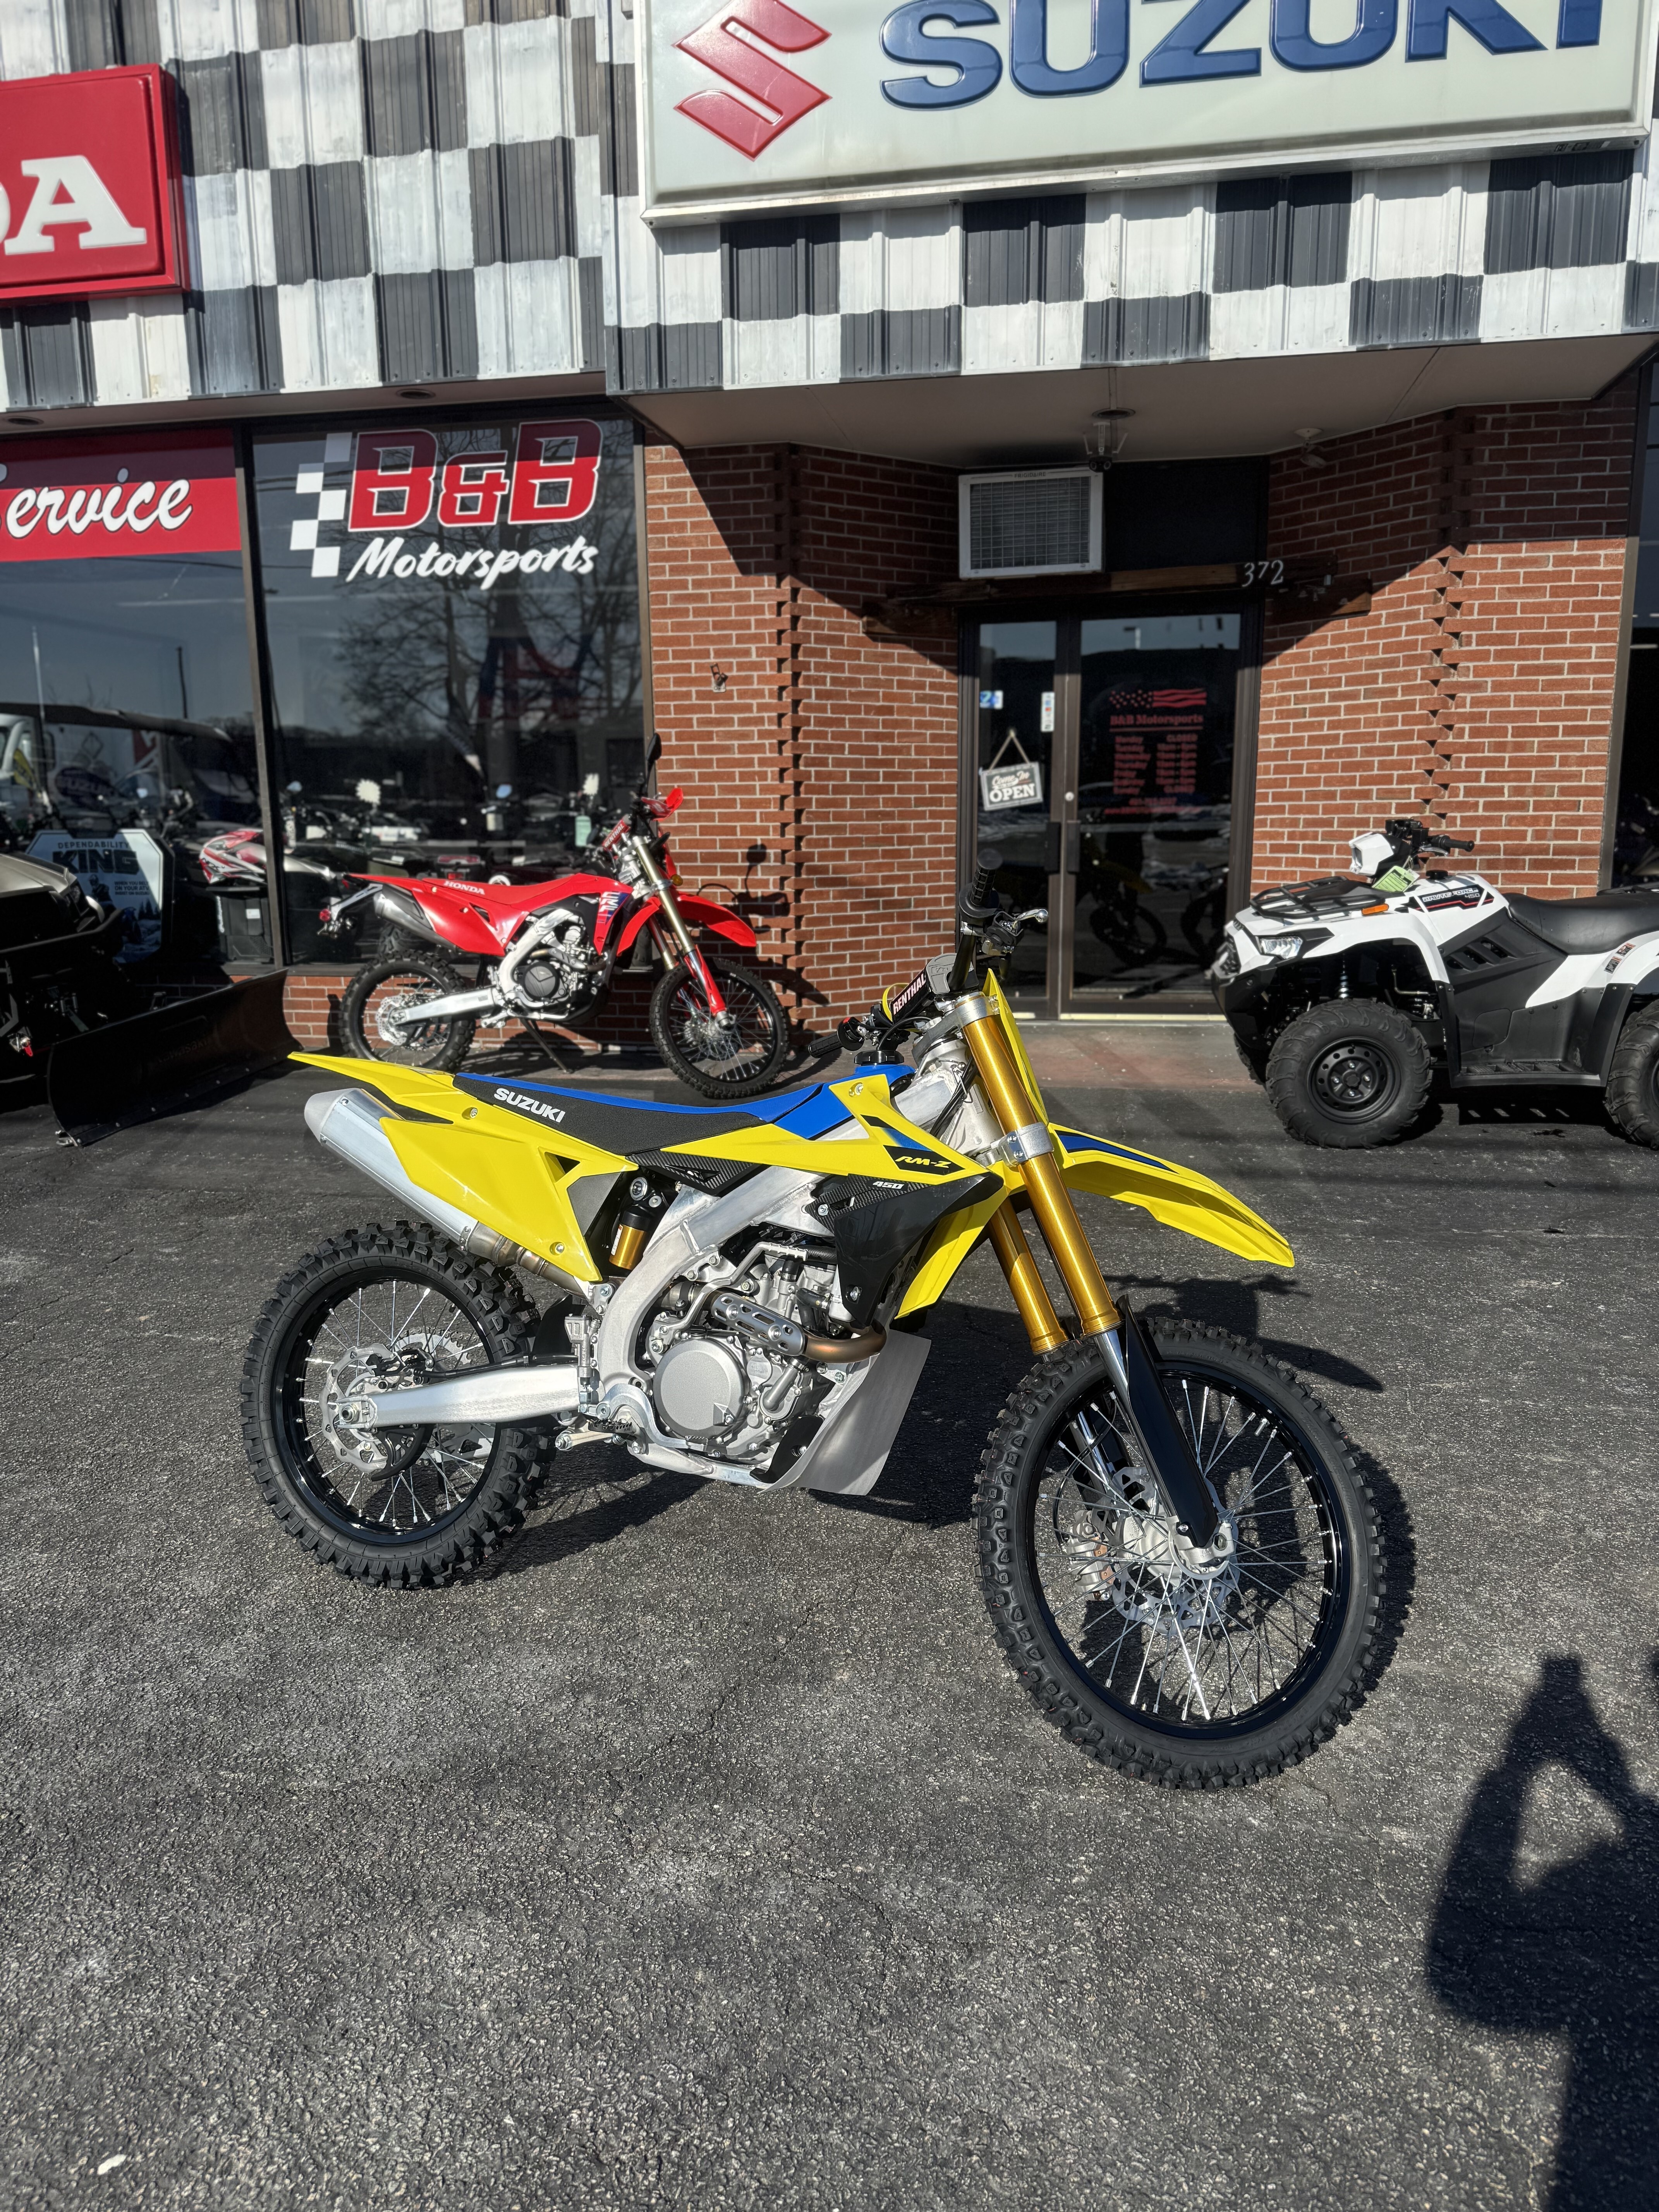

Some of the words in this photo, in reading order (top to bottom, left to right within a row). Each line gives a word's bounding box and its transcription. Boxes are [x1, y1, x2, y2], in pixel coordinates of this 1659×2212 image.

[347, 418, 602, 532] B&B
[0, 464, 192, 539] ervice
[345, 535, 598, 591] Motorsports
[1242, 559, 1284, 588] 372
[1135, 714, 1204, 725] Motorsports
[992, 775, 1015, 786] Come
[1017, 771, 1030, 780] In
[989, 783, 1035, 802] OPEN
[604, 823, 625, 847] RENTHAL
[53, 849, 139, 875] KING
[443, 880, 485, 895] HONDA
[893, 972, 926, 1015] RENTHAL
[494, 1088, 565, 1123] SUZUKI
[895, 1156, 952, 1168] RM-Z
[872, 1180, 906, 1190] 450
